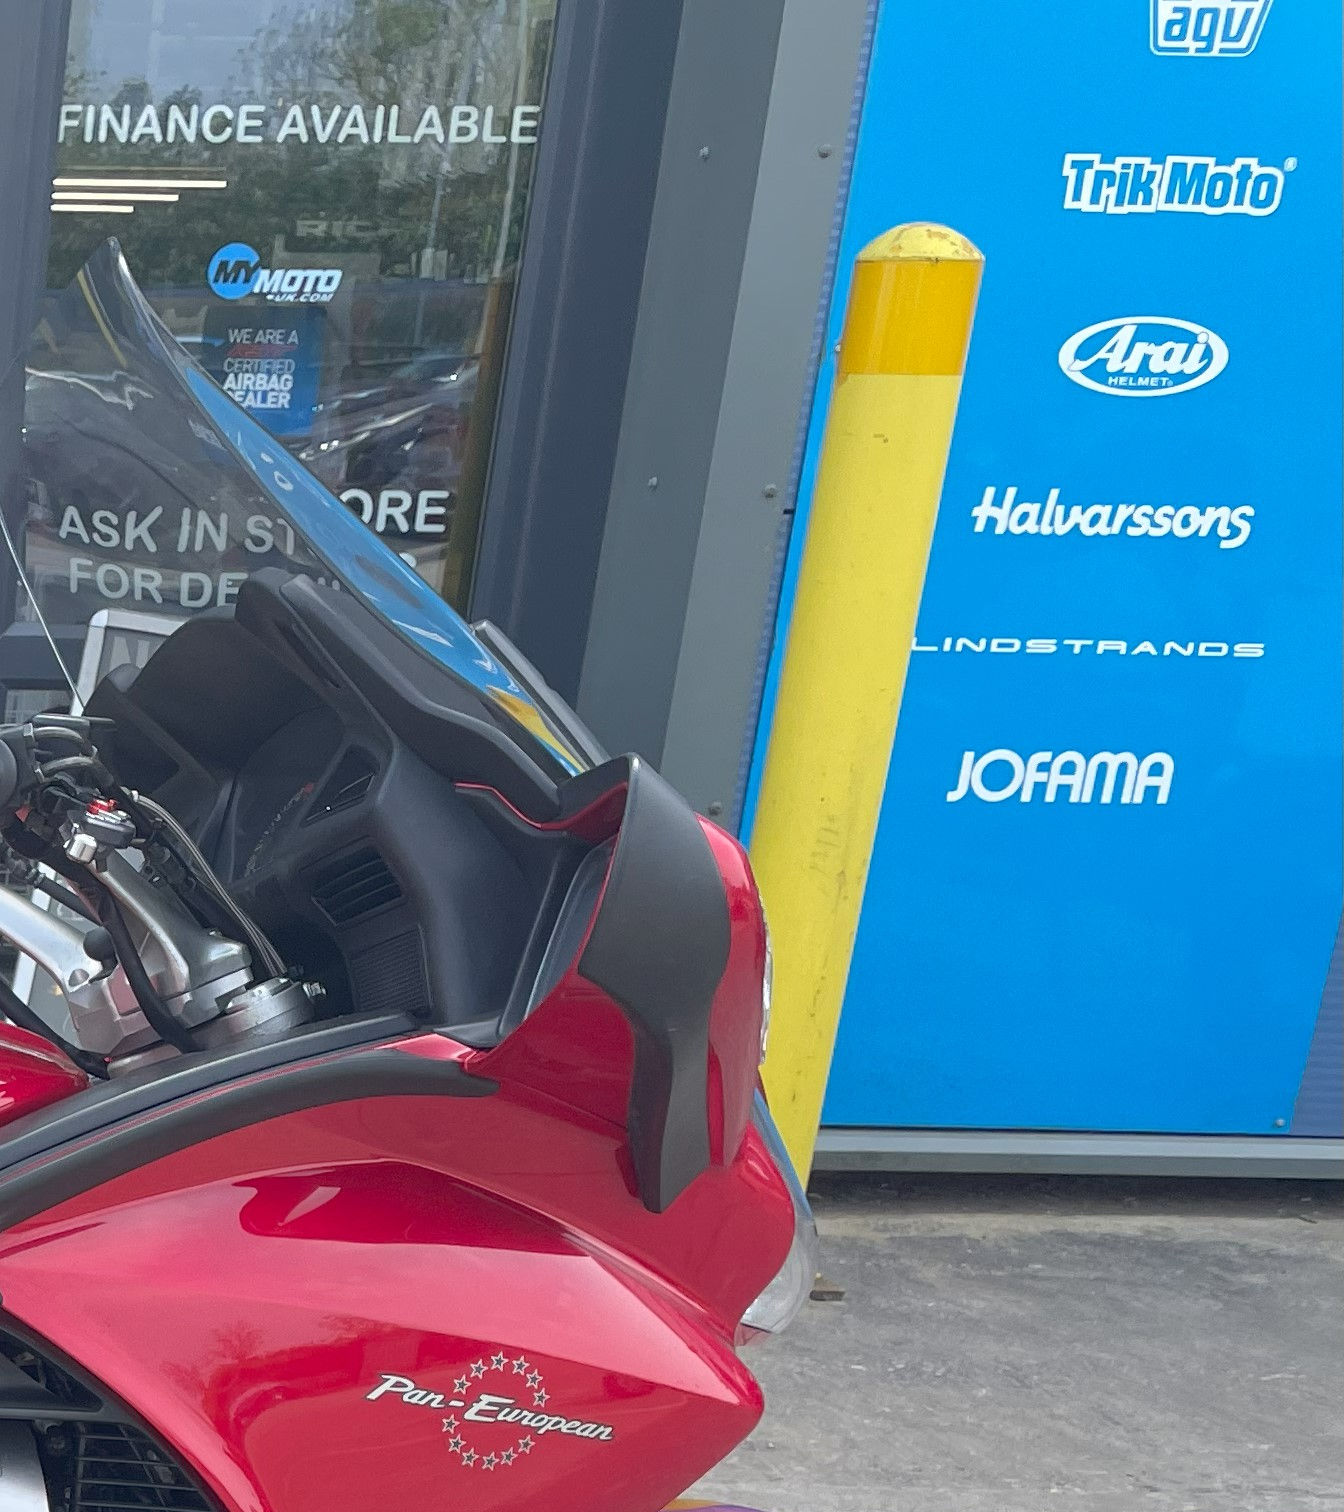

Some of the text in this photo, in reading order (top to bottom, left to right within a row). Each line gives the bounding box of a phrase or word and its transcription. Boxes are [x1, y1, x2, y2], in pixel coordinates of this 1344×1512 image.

[1162, 7, 1255, 54] agv
[57, 104, 540, 144] FINANCE AVAILABLE
[228, 329, 299, 344] WE ARE A
[1067, 324, 1210, 374] Arai
[223, 358, 295, 374] CERTIFIED
[223, 373, 294, 391] AIRBAG
[1108, 376, 1169, 387] HELMET
[58, 505, 163, 552] ASK
[177, 507, 228, 552] IN
[971, 486, 1254, 549] Halvarssons
[69, 557, 163, 604] FOR
[946, 748, 1175, 804] JOFAMA
